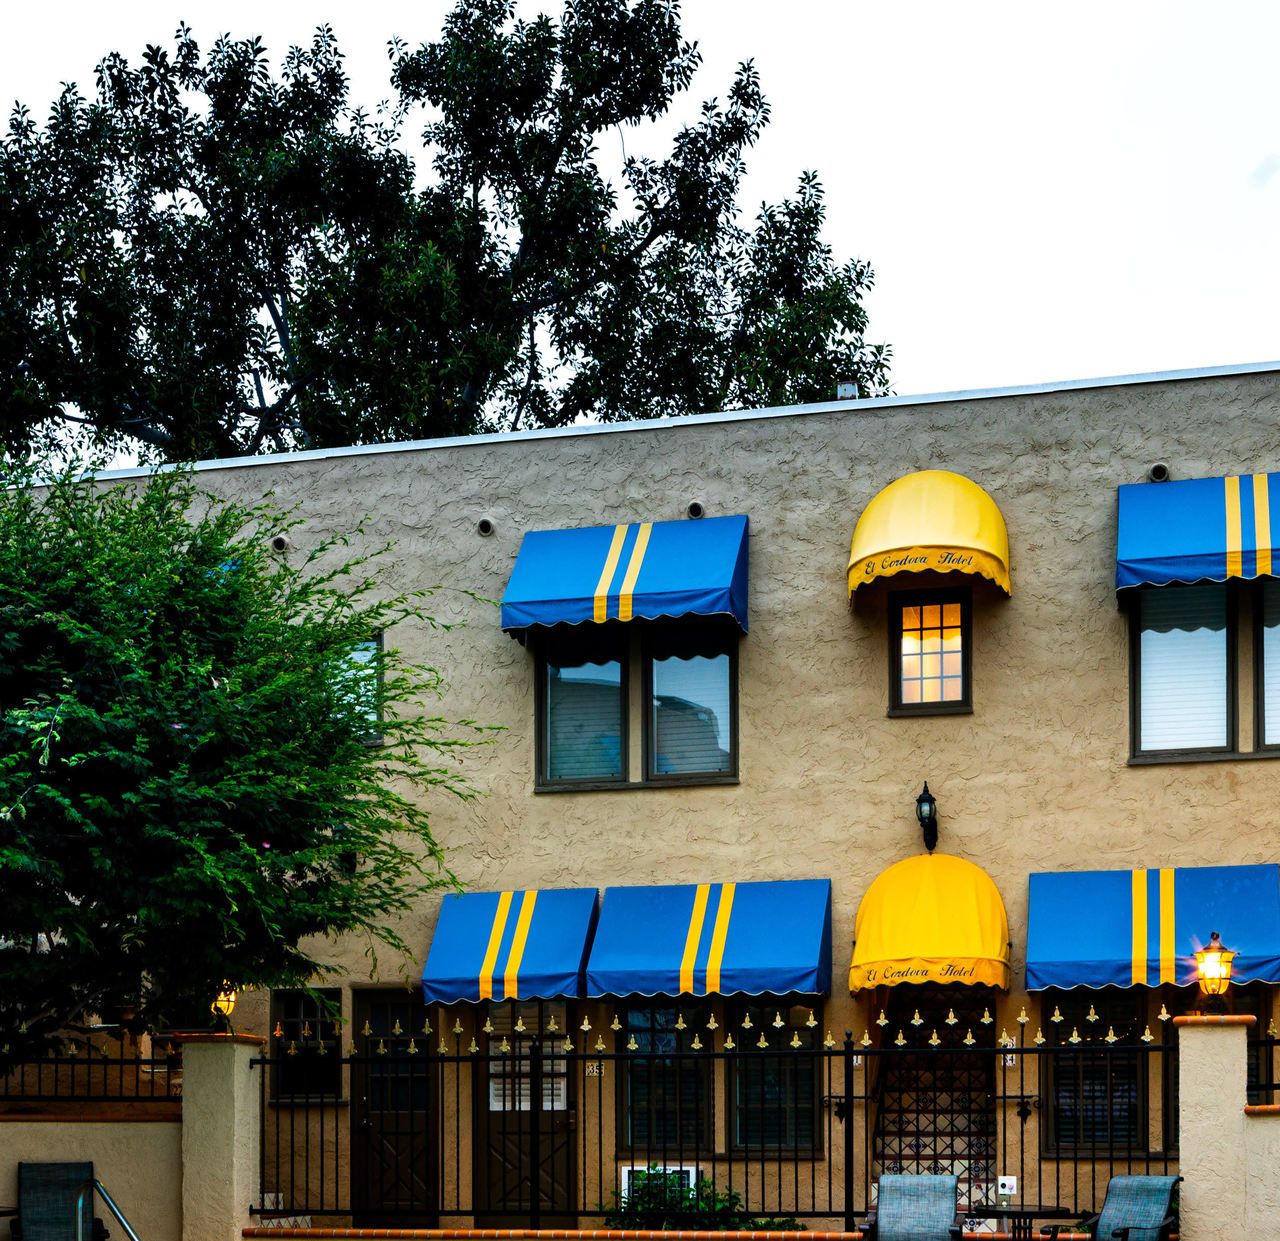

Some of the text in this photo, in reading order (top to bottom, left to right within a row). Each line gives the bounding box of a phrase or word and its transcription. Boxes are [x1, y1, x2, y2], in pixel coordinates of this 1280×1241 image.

[865, 551, 974, 575] El Cordova Hotel
[866, 964, 976, 981] El Cordova Hotel
